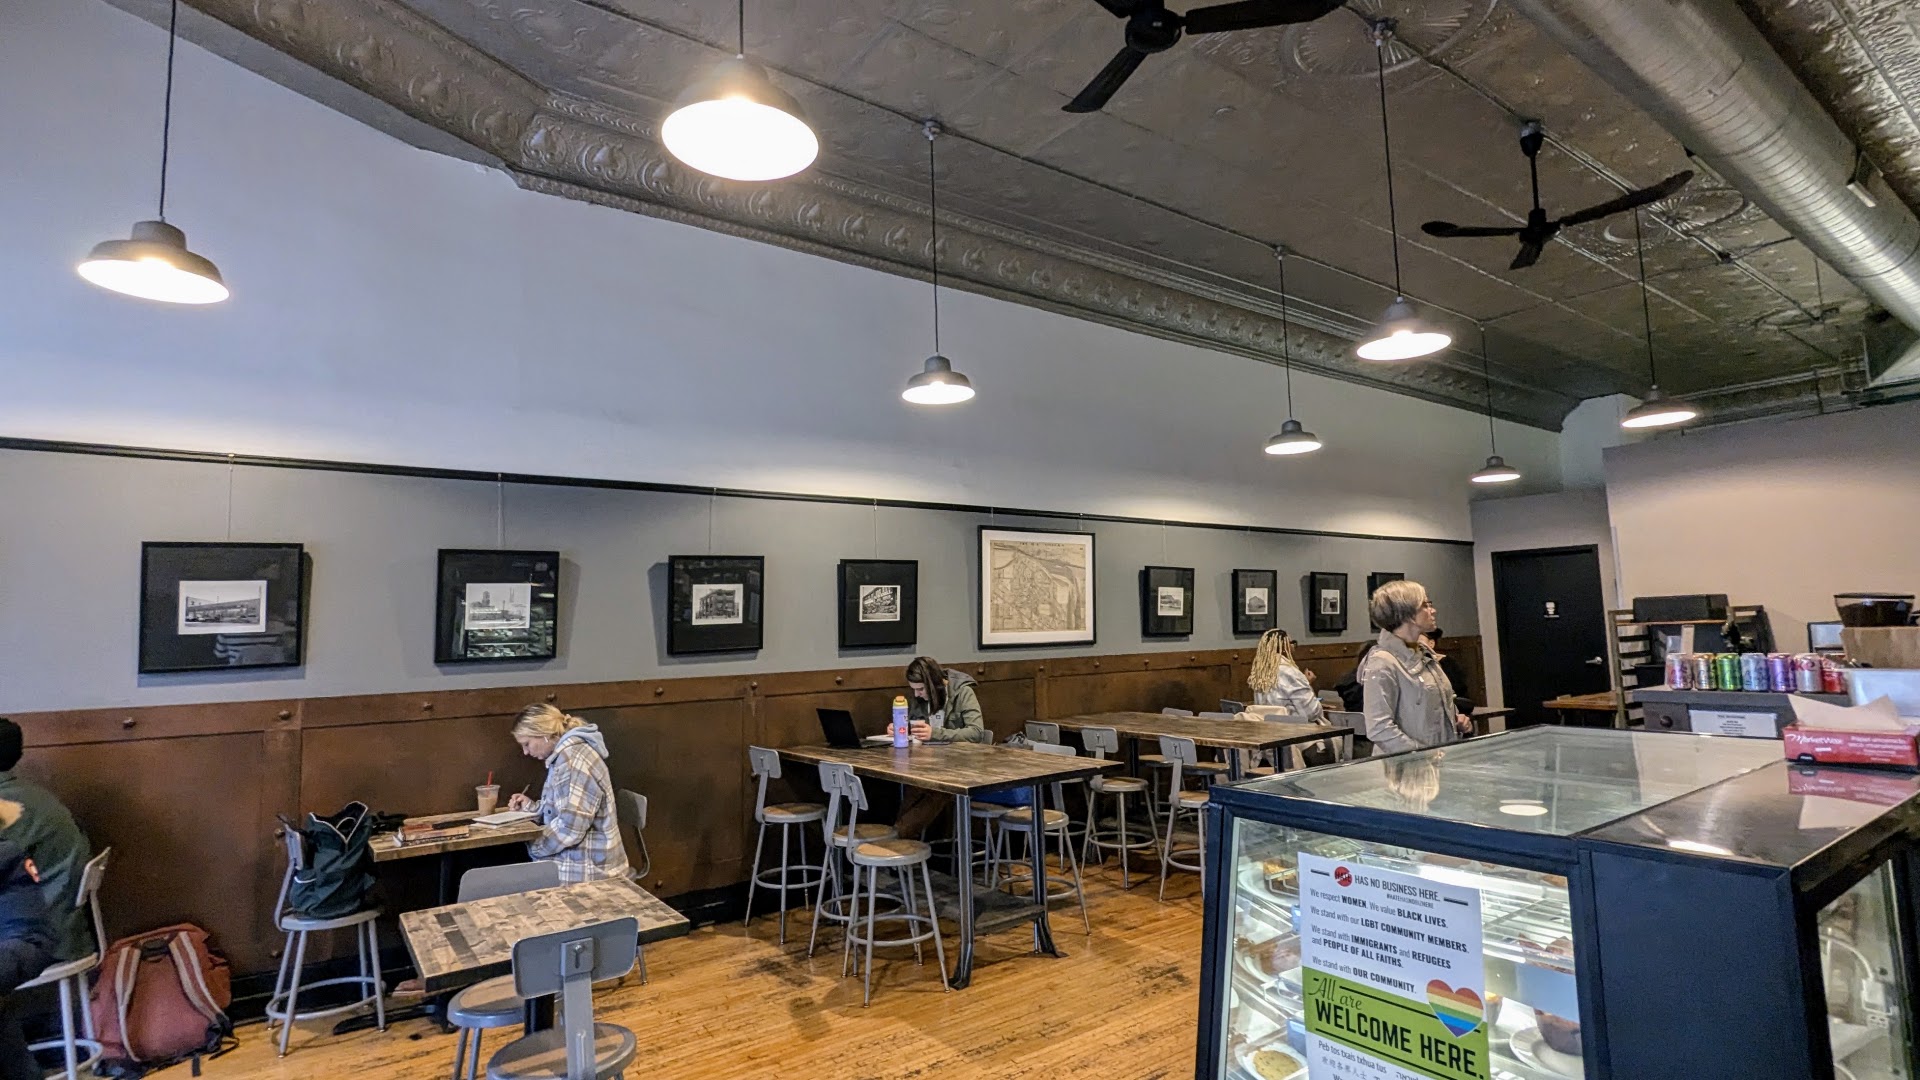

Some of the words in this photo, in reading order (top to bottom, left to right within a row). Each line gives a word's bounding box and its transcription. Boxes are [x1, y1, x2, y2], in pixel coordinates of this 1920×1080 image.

[1355, 875, 1369, 886] HAS
[1370, 878, 1380, 889] NO
[1382, 880, 1417, 897] BUSINESS
[1419, 888, 1441, 902] HERE.
[1310, 889, 1320, 898] We
[1320, 892, 1341, 905] respect
[1341, 895, 1368, 910] WOMEN.
[1369, 902, 1380, 912] We
[1380, 904, 1397, 916] value
[1397, 908, 1423, 922] BLACK
[1424, 914, 1448, 928] LIVES.
[1310, 906, 1320, 915] We
[1320, 908, 1336, 920] stand
[1336, 912, 1350, 922] with
[1350, 917, 1360, 925] our
[1360, 917, 1379, 930] LGBT
[1380, 922, 1425, 942] COMMUNITY
[1427, 932, 1470, 954] MEMBERS.
[1311, 924, 1321, 934] We
[1321, 927, 1337, 939] stand
[1337, 931, 1350, 942] with
[1351, 934, 1398, 955] IMMIGRANTS
[1399, 948, 1411, 959] and
[1411, 951, 1452, 969] REFUGEES
[1311, 936, 1322, 946] and
[1323, 938, 1349, 954] PEOPLE
[1350, 946, 1360, 956] OF
[1361, 949, 1375, 960] ALL
[1375, 953, 1404, 968] FAITHS.
[1308, 976, 1336, 1001] All
[1339, 993, 1362, 1011] are
[1312, 956, 1322, 965] We
[1322, 958, 1338, 970] stand
[1339, 963, 1352, 974] with
[1352, 967, 1368, 980] OUR
[1370, 972, 1417, 994] COMMUNITY.
[1315, 998, 1412, 1053] WELCOME
[1419, 1033, 1484, 1080] HERE.
[1318, 1040, 1330, 1052] Peb
[1330, 1045, 1341, 1056] tos
[1341, 1049, 1356, 1062] txais
[1356, 1056, 1375, 1070] txhua
[1376, 1063, 1387, 1074] tus
